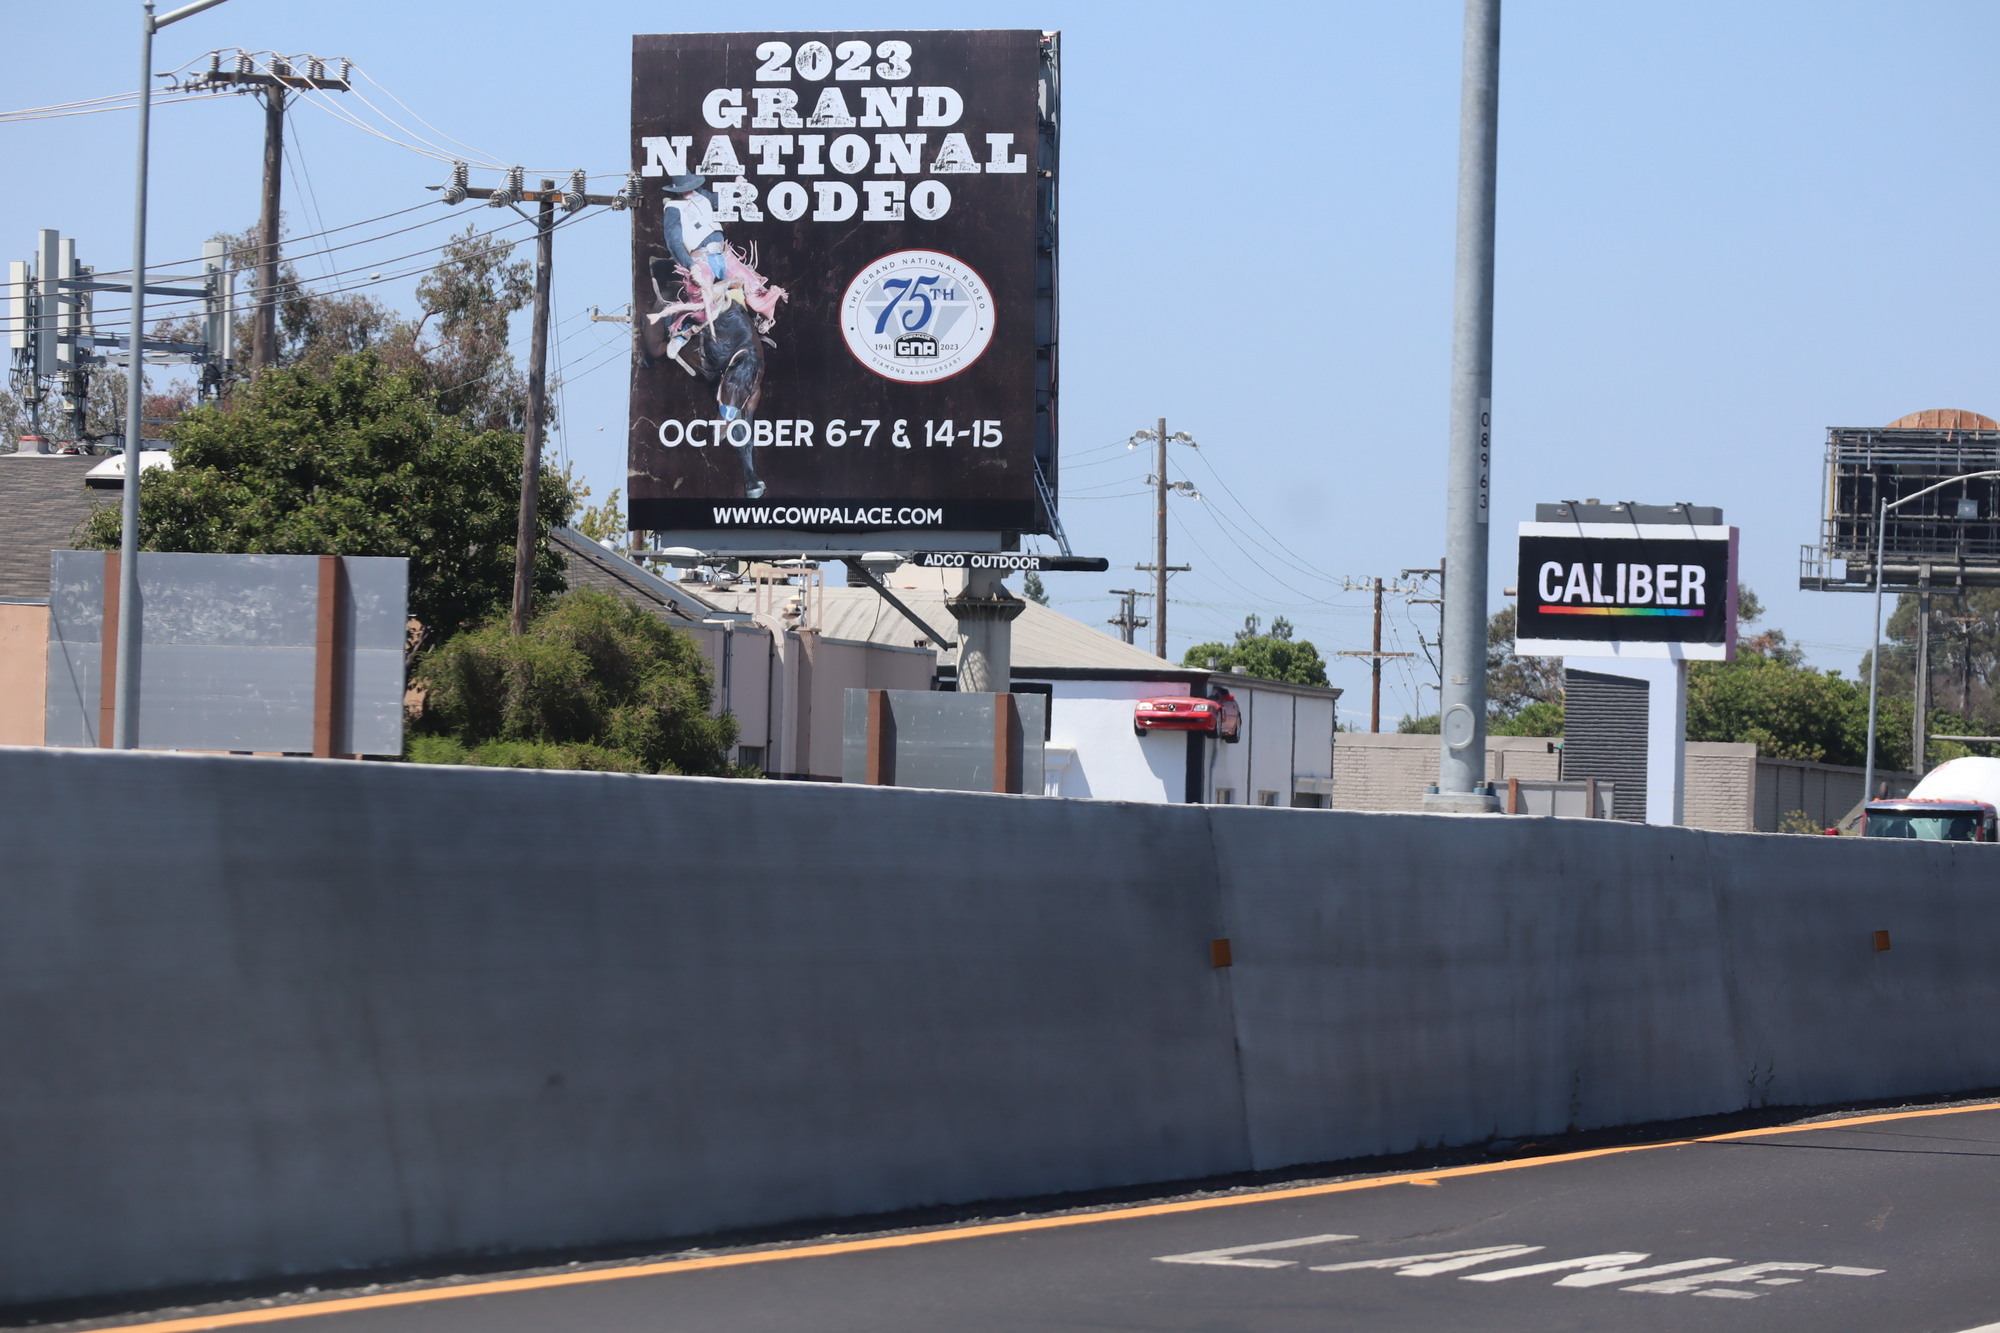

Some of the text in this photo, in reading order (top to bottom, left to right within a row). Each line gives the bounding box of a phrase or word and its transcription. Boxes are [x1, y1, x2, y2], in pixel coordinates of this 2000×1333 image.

[755, 40, 912, 81] 2023
[702, 86, 964, 128] GRAND
[641, 132, 1027, 177] NATIONAL
[712, 180, 952, 222] RODEO
[849, 257, 986, 310] THE GRAND NATIONAL RODEO
[872, 356, 962, 376] DIAMOND ANNIVERSARY
[874, 343, 892, 351] 1941
[940, 343, 959, 351] 2023
[658, 419, 1003, 449] OCTOBER 6-7 & 14-15
[1480, 411, 1489, 509] 08963
[713, 506, 943, 526] WWW.COWPALACE.COM
[923, 552, 1040, 571] ADCO OUTDOOR
[1538, 560, 1706, 606] CALIBER
